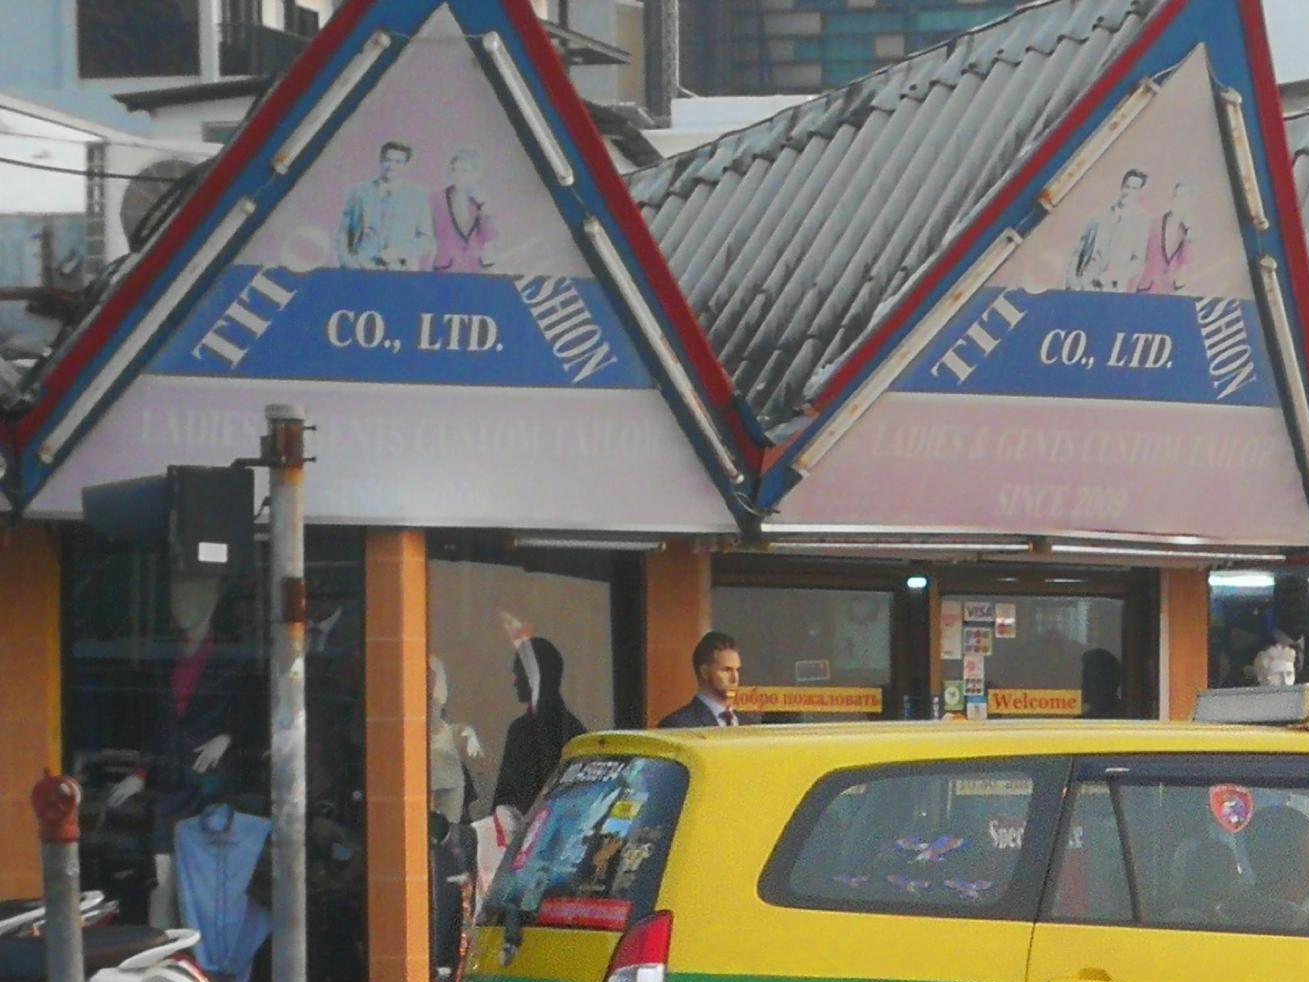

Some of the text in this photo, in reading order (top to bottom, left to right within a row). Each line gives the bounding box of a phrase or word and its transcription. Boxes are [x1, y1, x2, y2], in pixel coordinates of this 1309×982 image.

[326, 309, 504, 354] CO., LTD.
[1039, 328, 1173, 370] CO., LTD.
[967, 606, 993, 618] VISA
[992, 691, 1077, 711] Welcome
